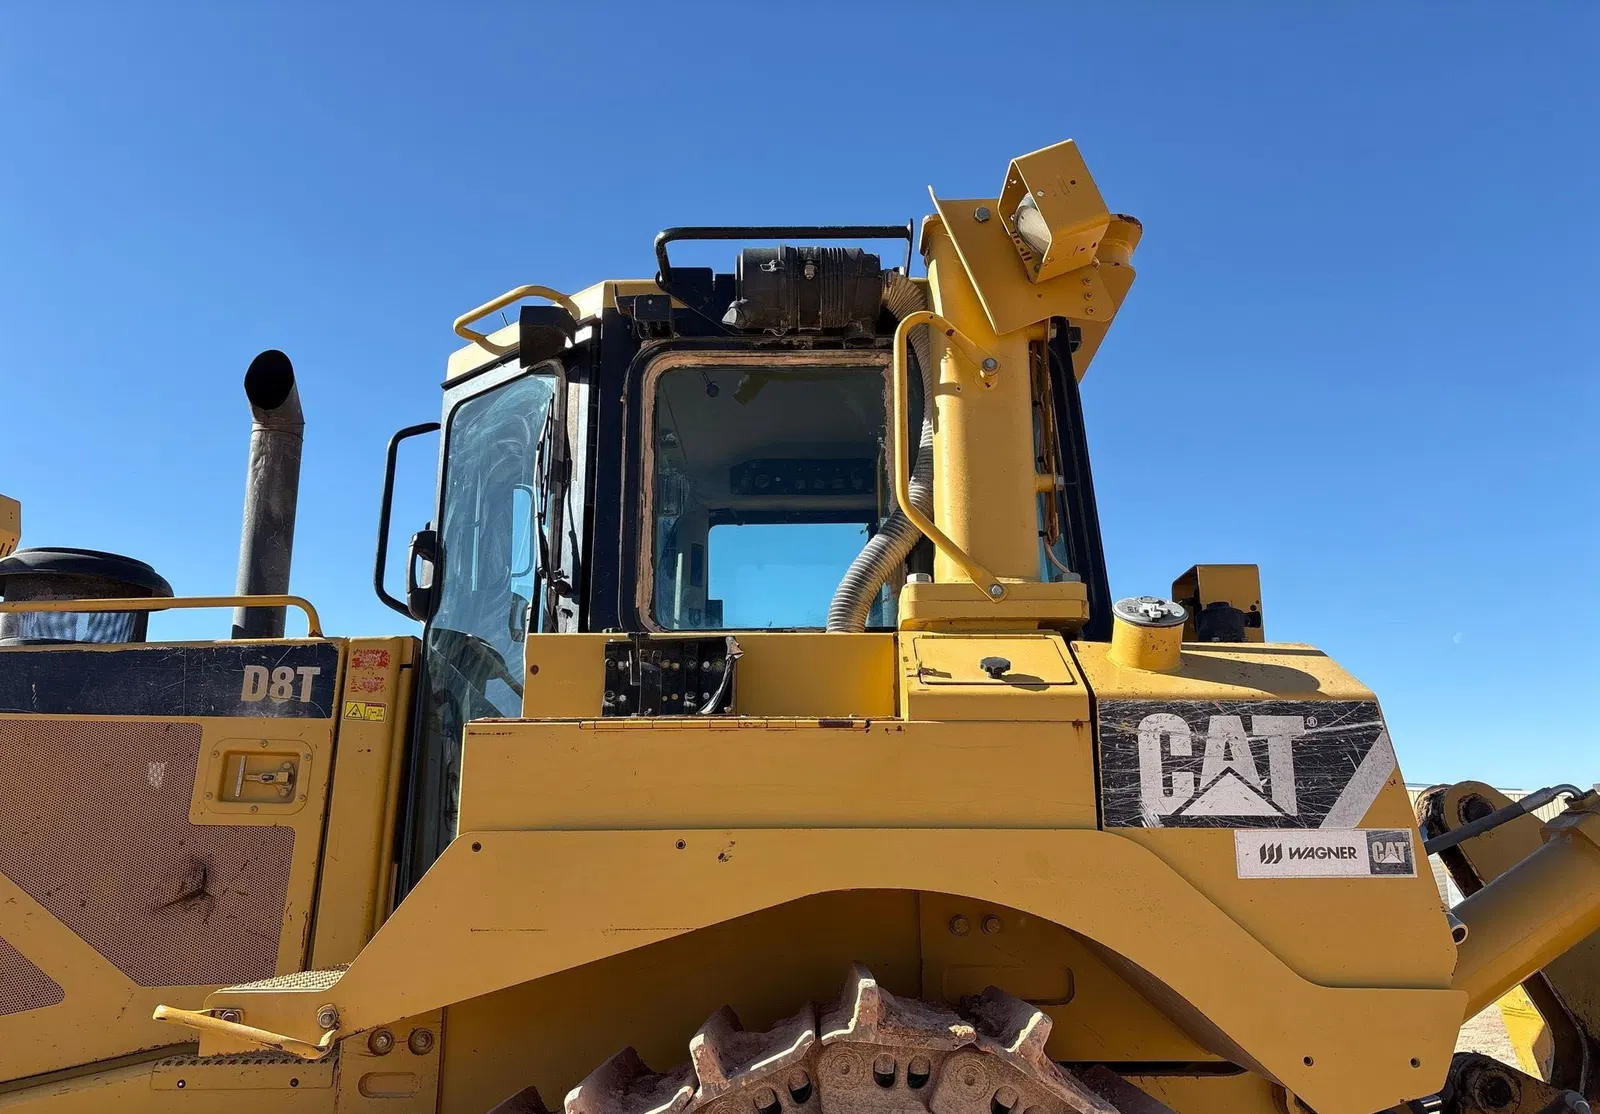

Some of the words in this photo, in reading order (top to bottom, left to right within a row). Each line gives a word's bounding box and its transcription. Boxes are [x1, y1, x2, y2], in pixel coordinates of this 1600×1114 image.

[241, 665, 321, 703] D8T
[1138, 713, 1304, 816] CAT
[1289, 846, 1358, 860] WAGNER
[1371, 841, 1407, 864] CAT
